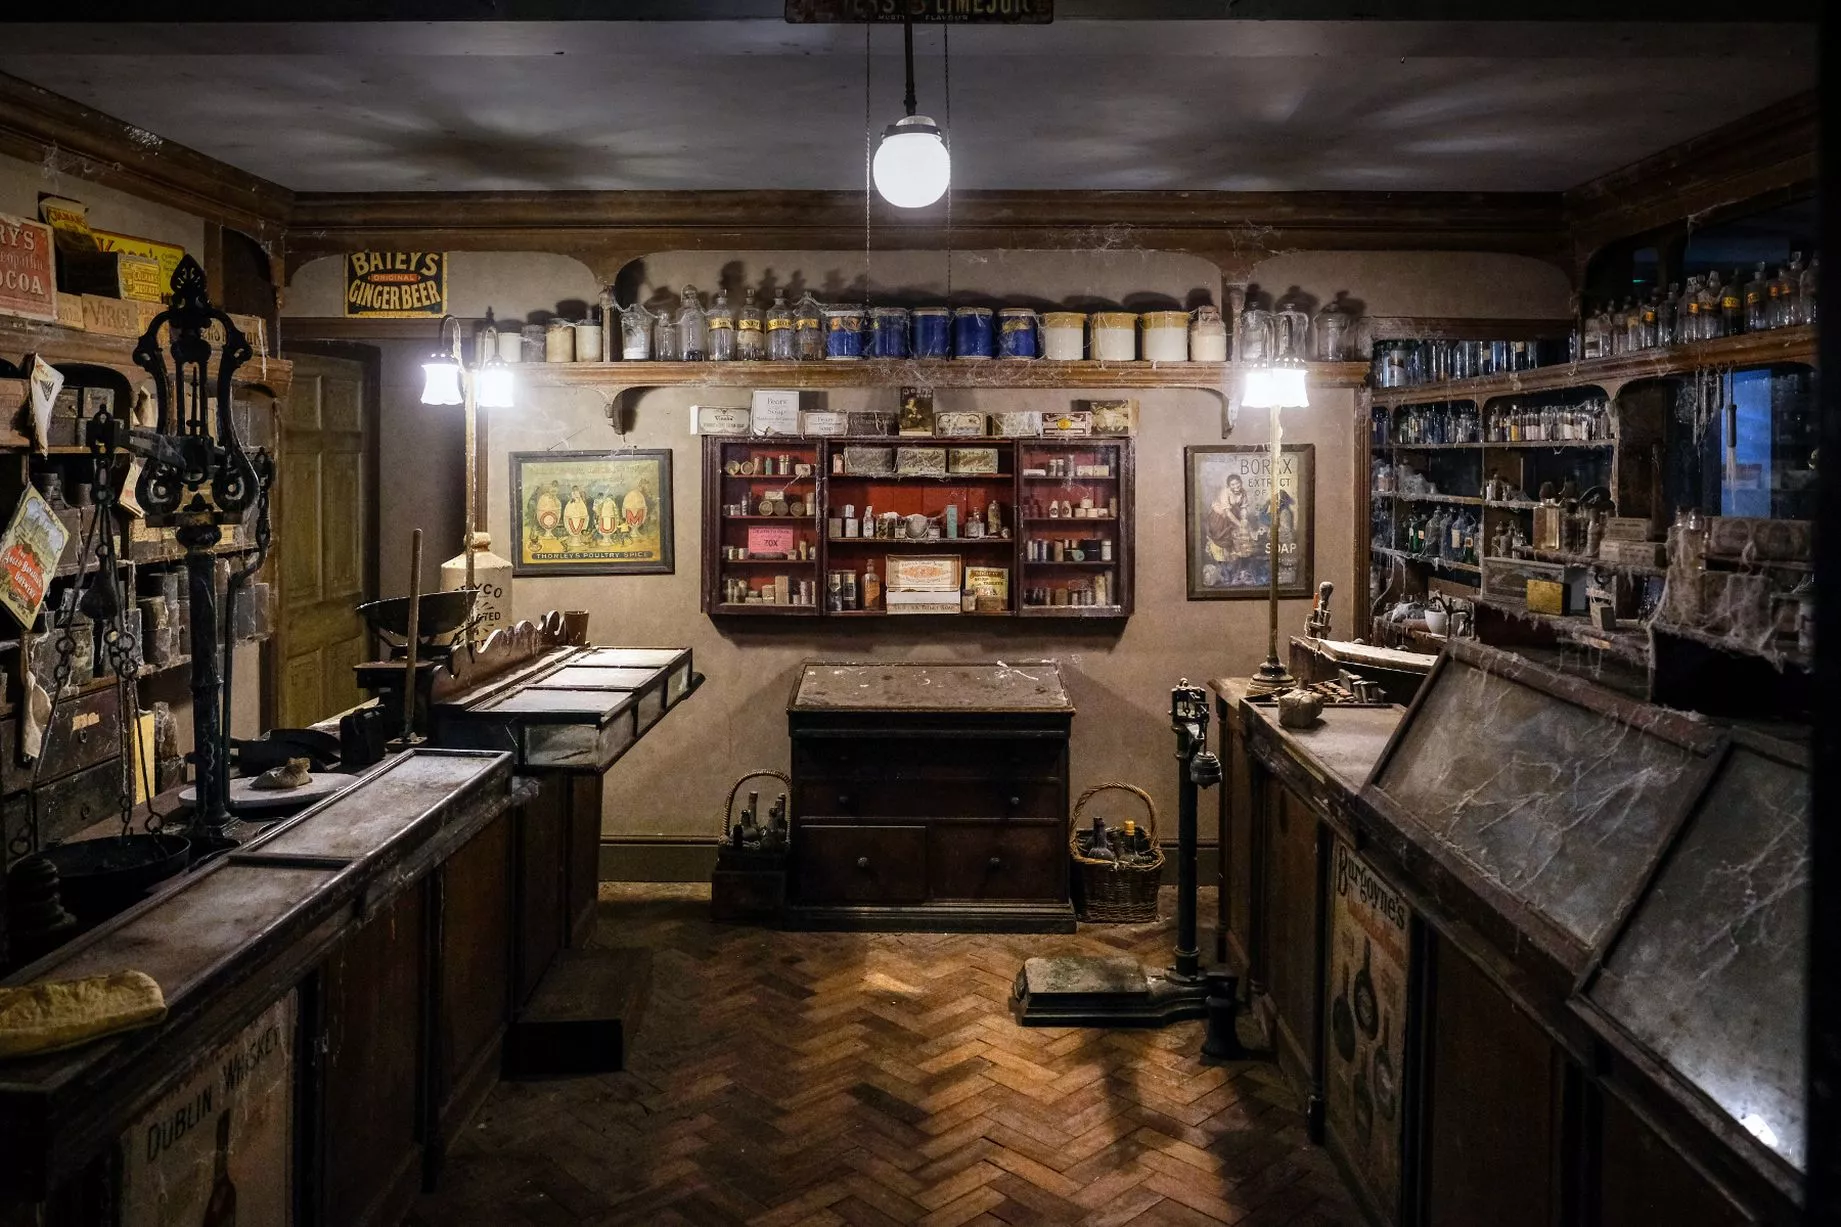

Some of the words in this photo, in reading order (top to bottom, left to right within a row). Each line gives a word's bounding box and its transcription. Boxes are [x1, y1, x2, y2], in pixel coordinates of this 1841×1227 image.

[373, 273, 415, 281] ORIGINAL
[348, 278, 401, 310] GINGER
[401, 279, 441, 309] BEER
[1240, 458, 1293, 475] BORX
[1248, 478, 1291, 488] EXTRCT
[540, 510, 645, 535] OVUM
[1337, 845, 1406, 930] Burgoyne's
[147, 1086, 213, 1163] DUBLIN
